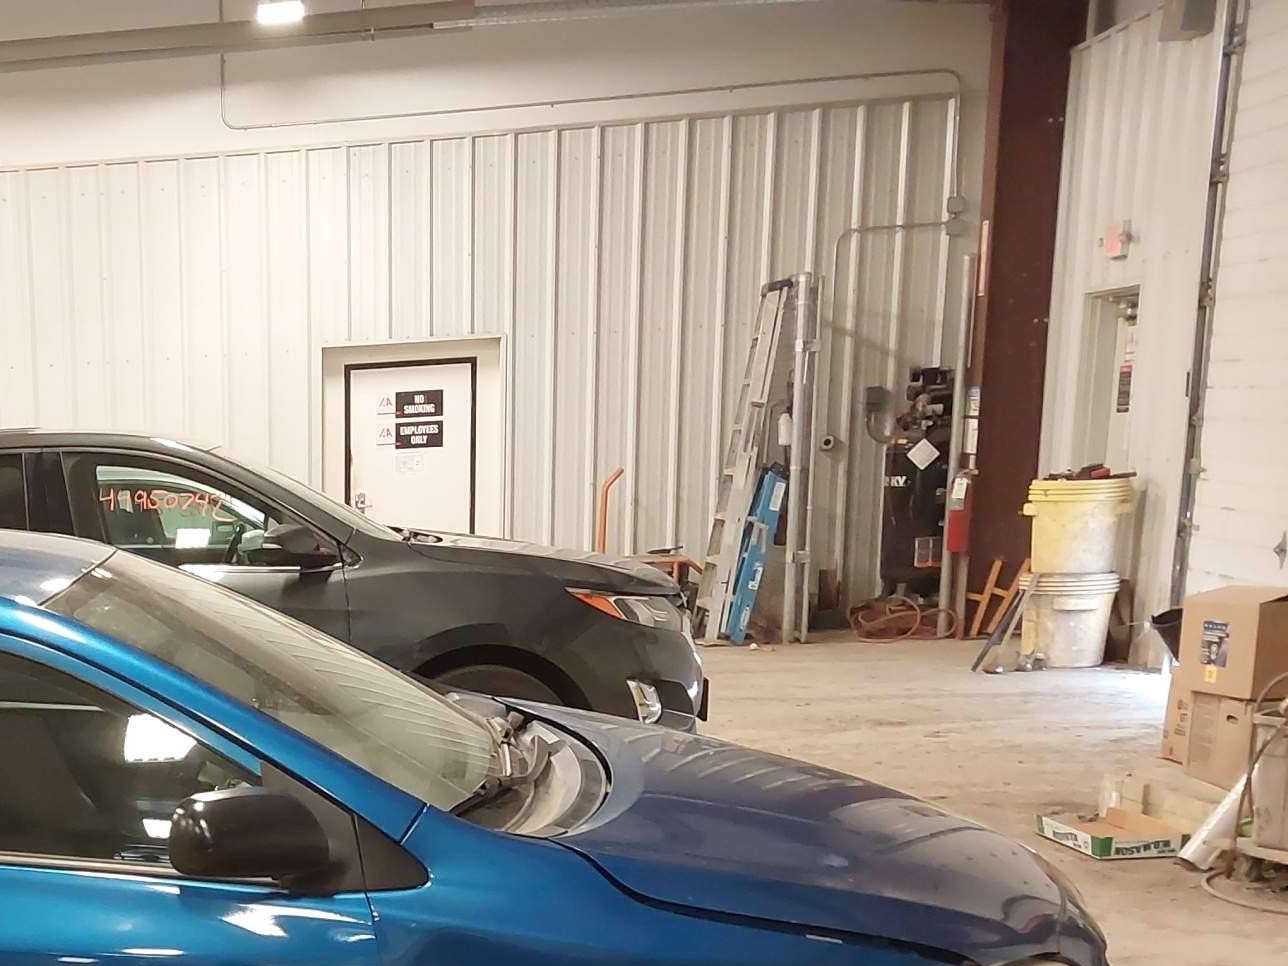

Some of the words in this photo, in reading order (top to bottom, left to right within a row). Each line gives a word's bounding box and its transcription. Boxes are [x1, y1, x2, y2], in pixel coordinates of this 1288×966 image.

[414, 394, 425, 403] NO
[403, 404, 435, 414] SMOKING
[399, 424, 439, 435] EMPLOYEES
[410, 435, 428, 445] ONLY
